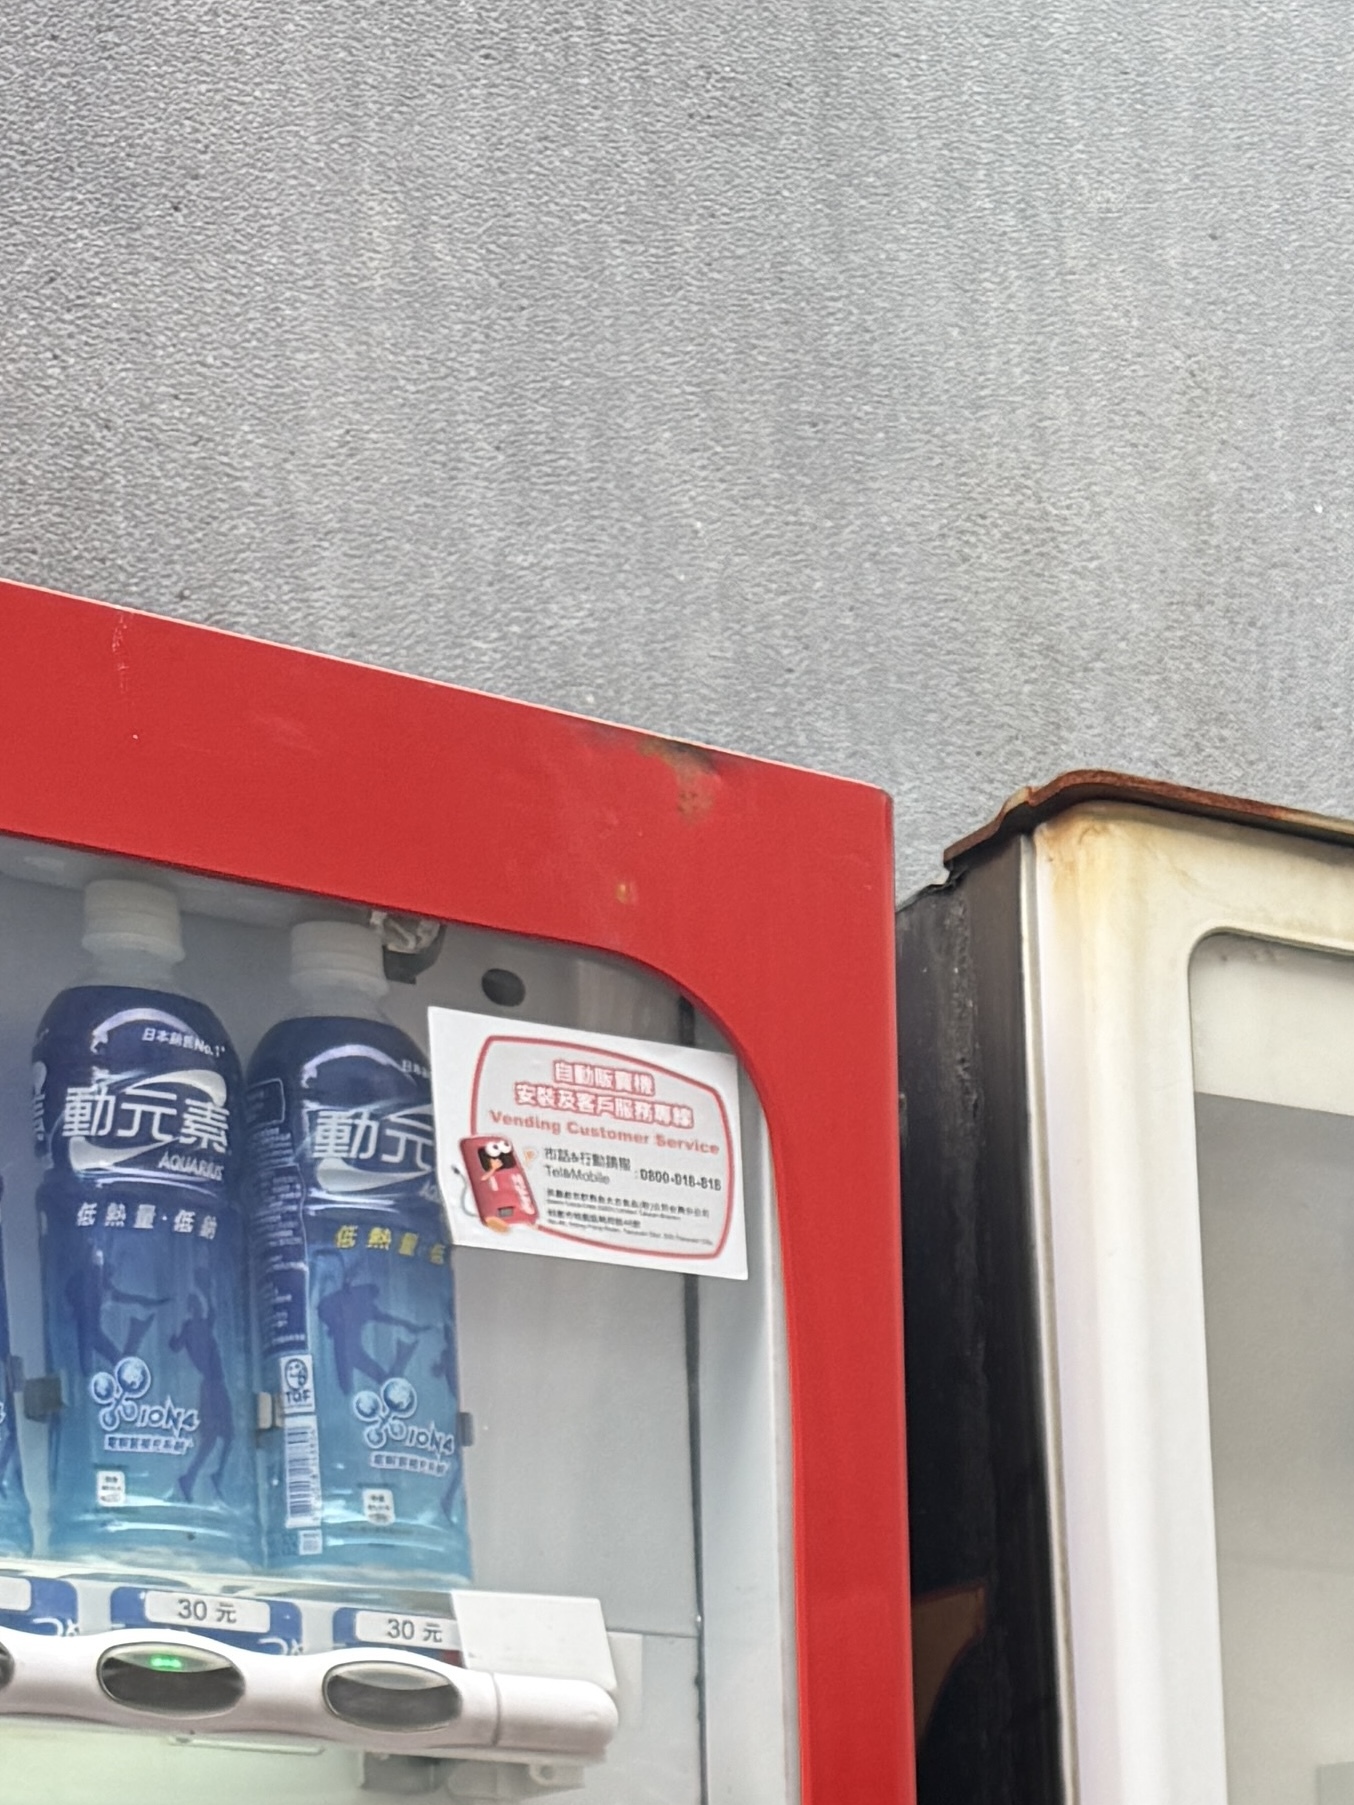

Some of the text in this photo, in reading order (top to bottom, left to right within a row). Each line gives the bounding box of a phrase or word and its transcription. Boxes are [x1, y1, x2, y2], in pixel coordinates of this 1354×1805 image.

[553, 1060, 655, 1096] 自動販賣機
[61, 1082, 230, 1154] 動元素
[489, 1110, 720, 1155] Vending Customer Service
[178, 1600, 237, 1624] 30 元
[387, 1619, 443, 1645] 30 元
